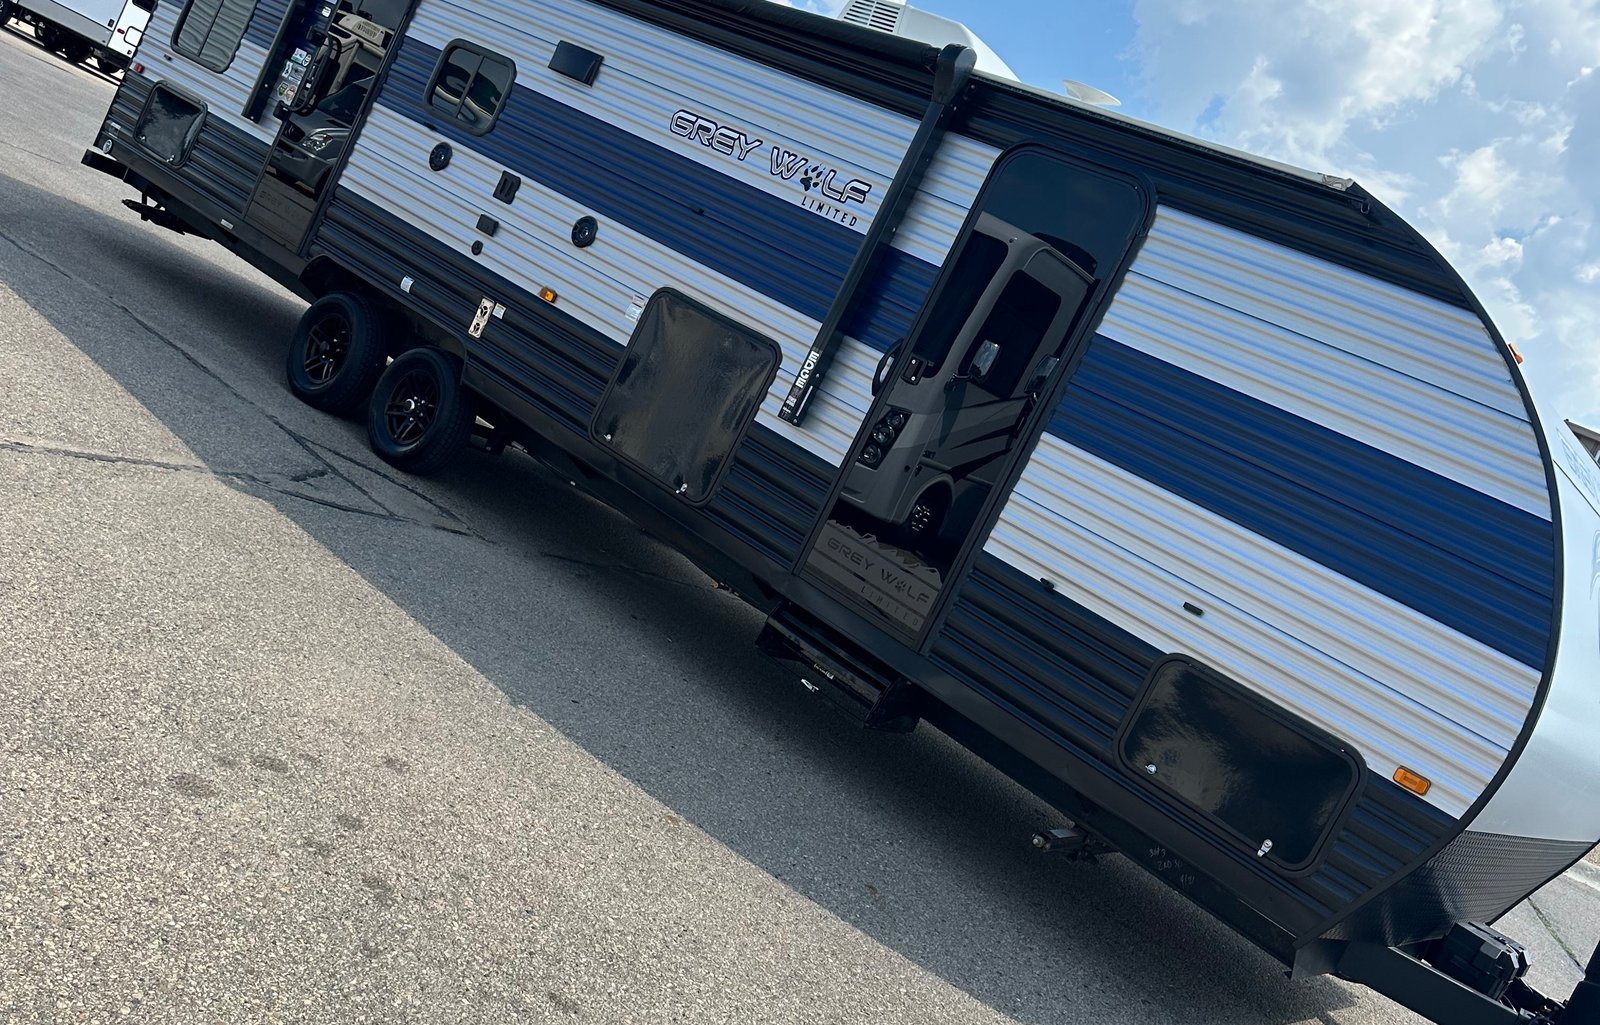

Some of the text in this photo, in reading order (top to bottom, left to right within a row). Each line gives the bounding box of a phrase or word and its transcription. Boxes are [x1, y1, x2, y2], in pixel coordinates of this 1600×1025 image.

[670, 109, 763, 161] GREY
[801, 196, 858, 227] LIMITED
[795, 350, 820, 389] EDGE
[827, 538, 875, 570] GREY
